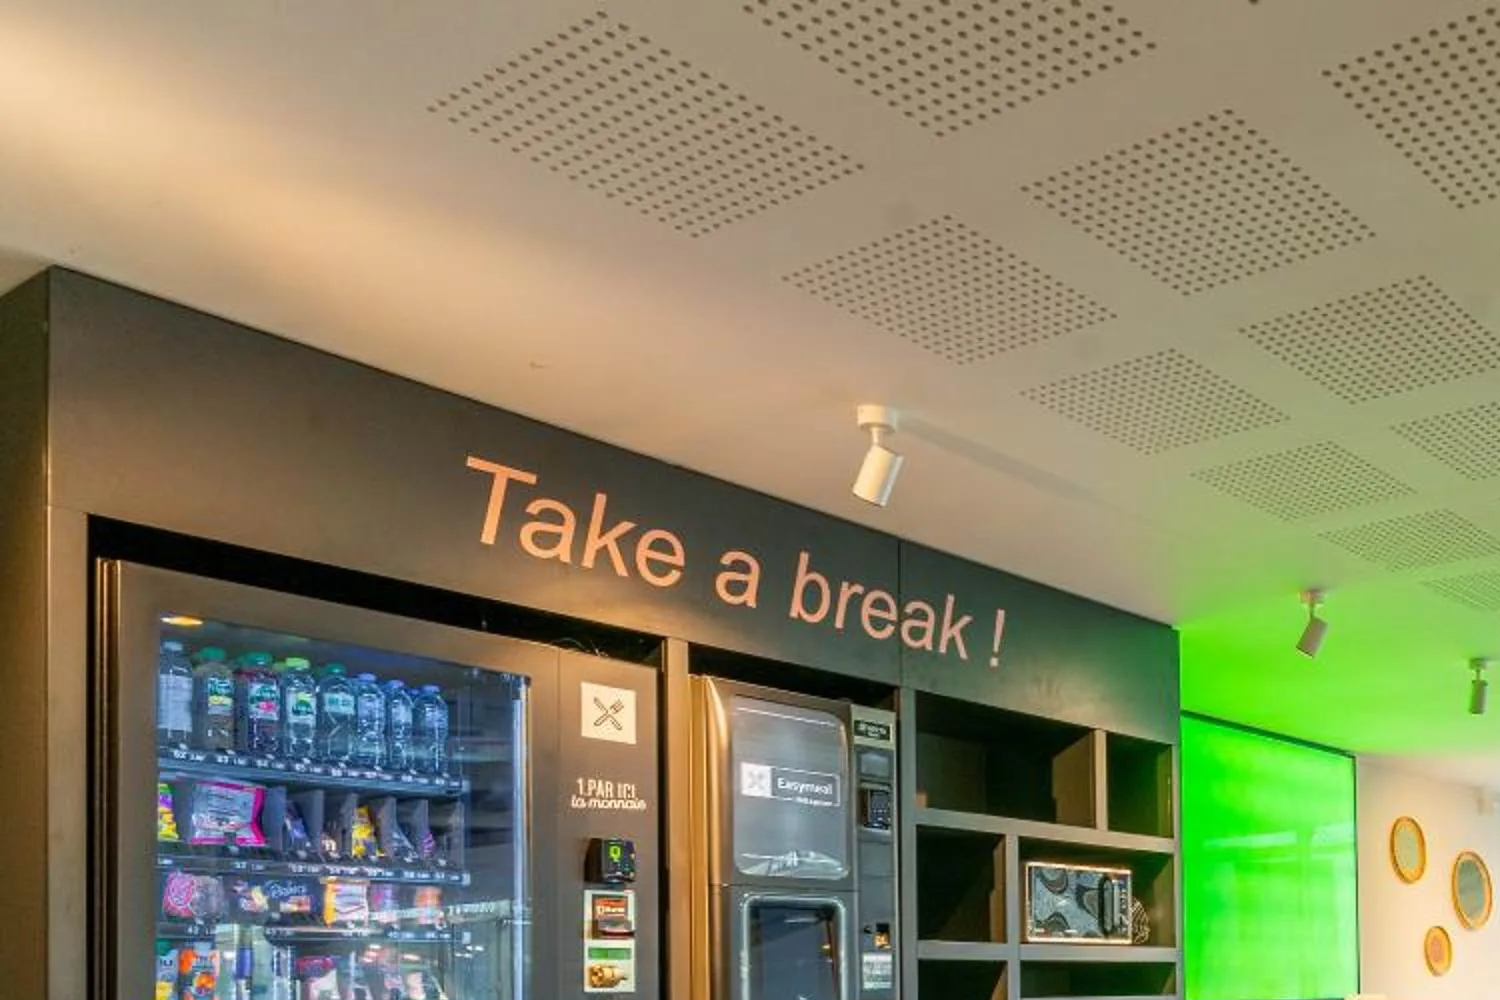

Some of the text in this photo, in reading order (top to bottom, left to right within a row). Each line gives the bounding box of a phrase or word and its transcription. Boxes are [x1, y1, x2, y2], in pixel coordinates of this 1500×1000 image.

[466, 456, 686, 588] Take
[715, 550, 761, 608] a
[789, 551, 974, 660] break
